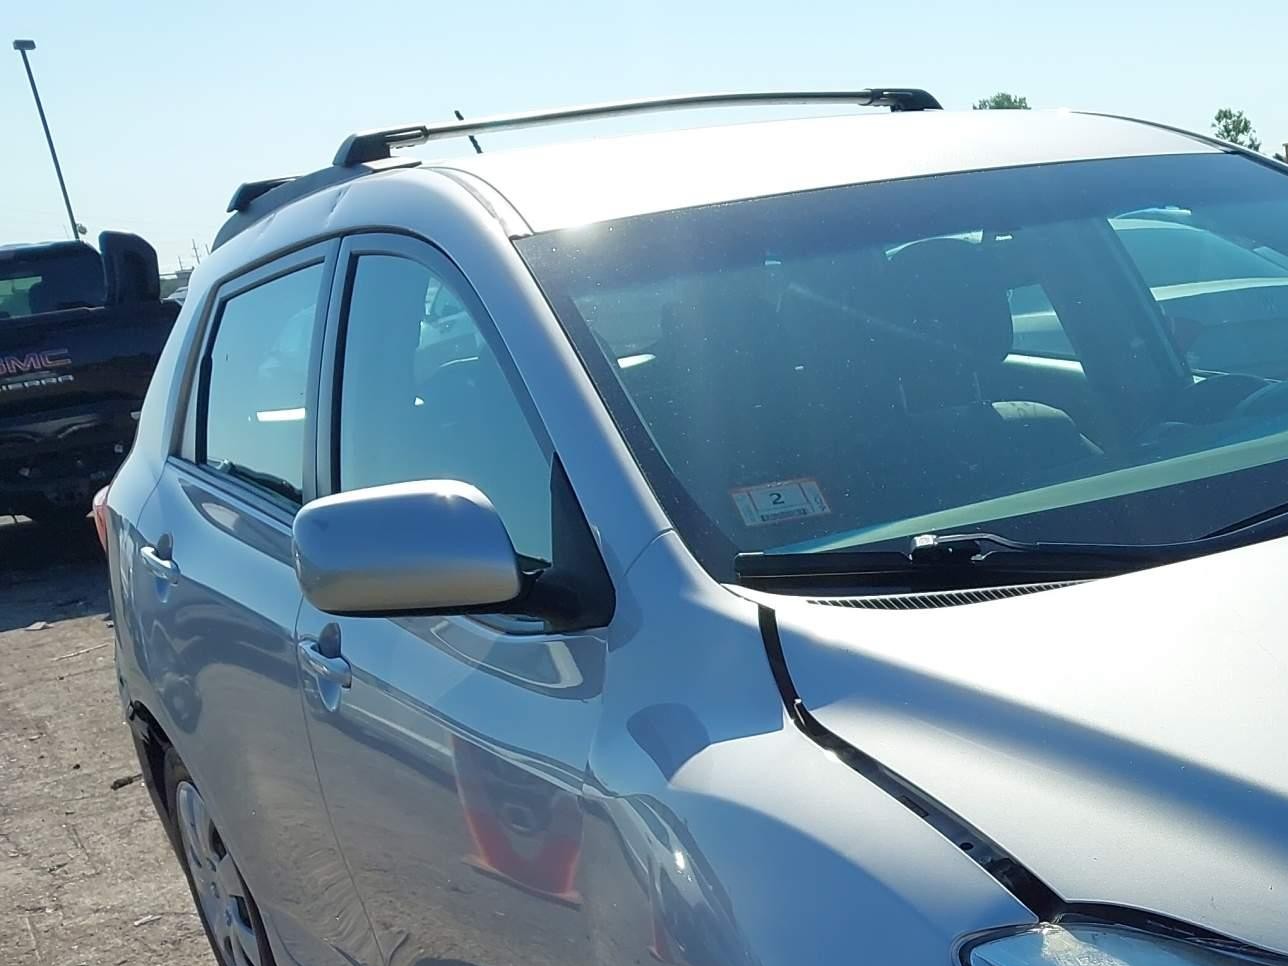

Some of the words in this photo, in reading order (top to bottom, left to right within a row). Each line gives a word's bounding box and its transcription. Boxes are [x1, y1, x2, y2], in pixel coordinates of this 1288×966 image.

[0, 348, 72, 375] MC
[0, 374, 74, 391] IERRA
[769, 492, 785, 505] 2
